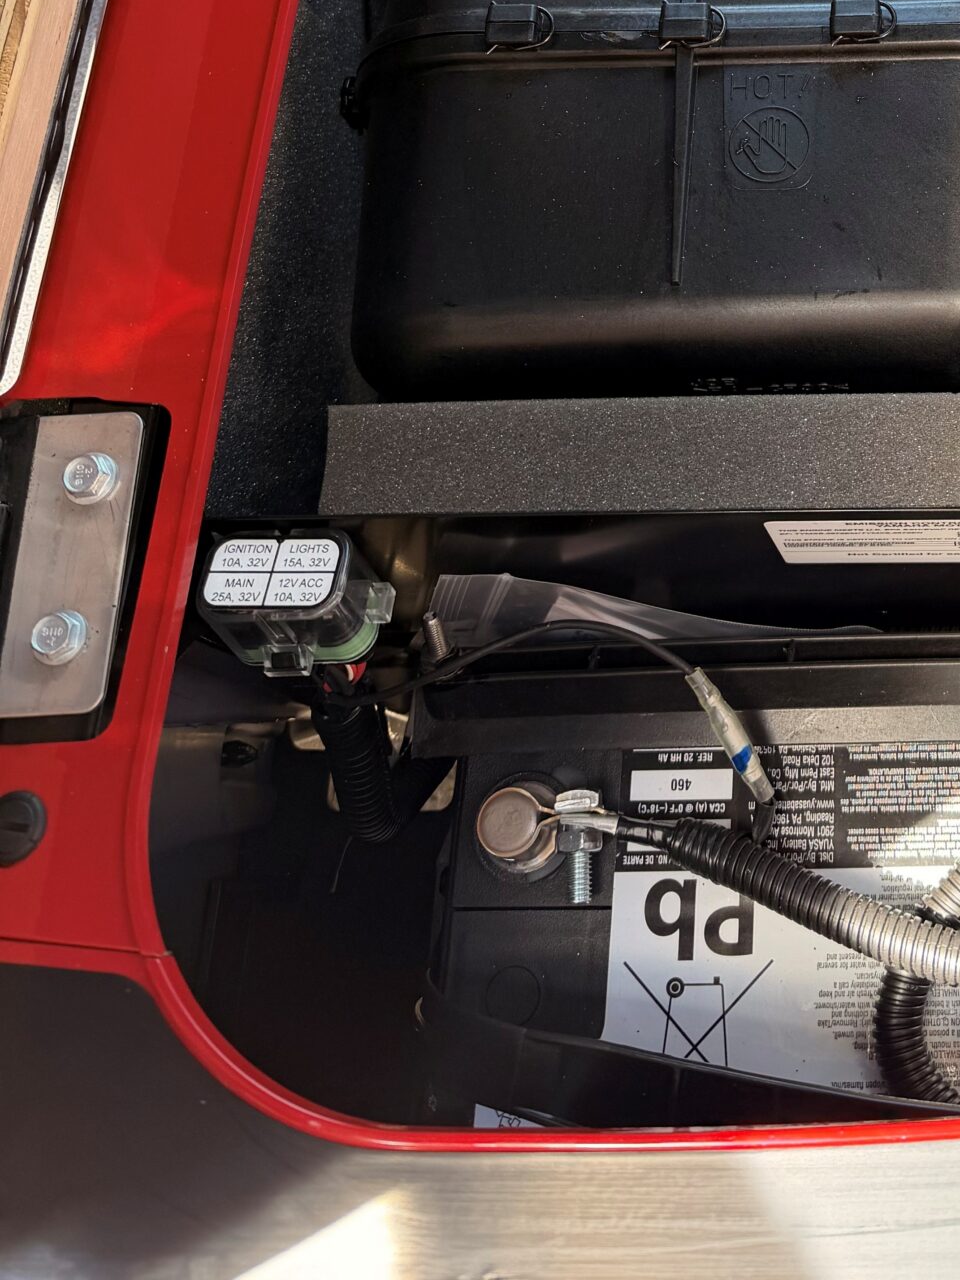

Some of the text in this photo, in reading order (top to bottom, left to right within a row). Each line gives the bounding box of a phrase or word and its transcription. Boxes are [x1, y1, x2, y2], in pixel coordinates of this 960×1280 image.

[224, 544, 273, 554] IGNITION
[289, 544, 330, 554] LIGHTS
[222, 558, 270, 568] 10A, 32V
[283, 558, 331, 568] 15A, 32V
[224, 579, 255, 587] MAIN
[279, 578, 324, 587] 12V ACC
[211, 592, 261, 603] 25A, 32V
[273, 592, 322, 602] 10A, 32V
[658, 752, 713, 762] REF. 20 HR Ah
[780, 754, 835, 766] 102 Deka Road,
[783, 766, 799, 779] Mfg.
[801, 768, 818, 779] Penn
[820, 767, 835, 779] East
[671, 778, 692, 791] 460
[818, 780, 835, 792] Mfd.
[685, 803, 694, 811] @
[695, 801, 707, 812] (A)
[708, 802, 725, 812] CCA
[791, 811, 835, 824] Reading, PA
[781, 825, 835, 837] 2901 Montrose
[780, 837, 807, 850] Battery,
[809, 839, 835, 850] YUASA
[622, 855, 668, 865] NO. DE PARTE
[818, 851, 834, 863] Dist.
[644, 877, 755, 960] Pb
